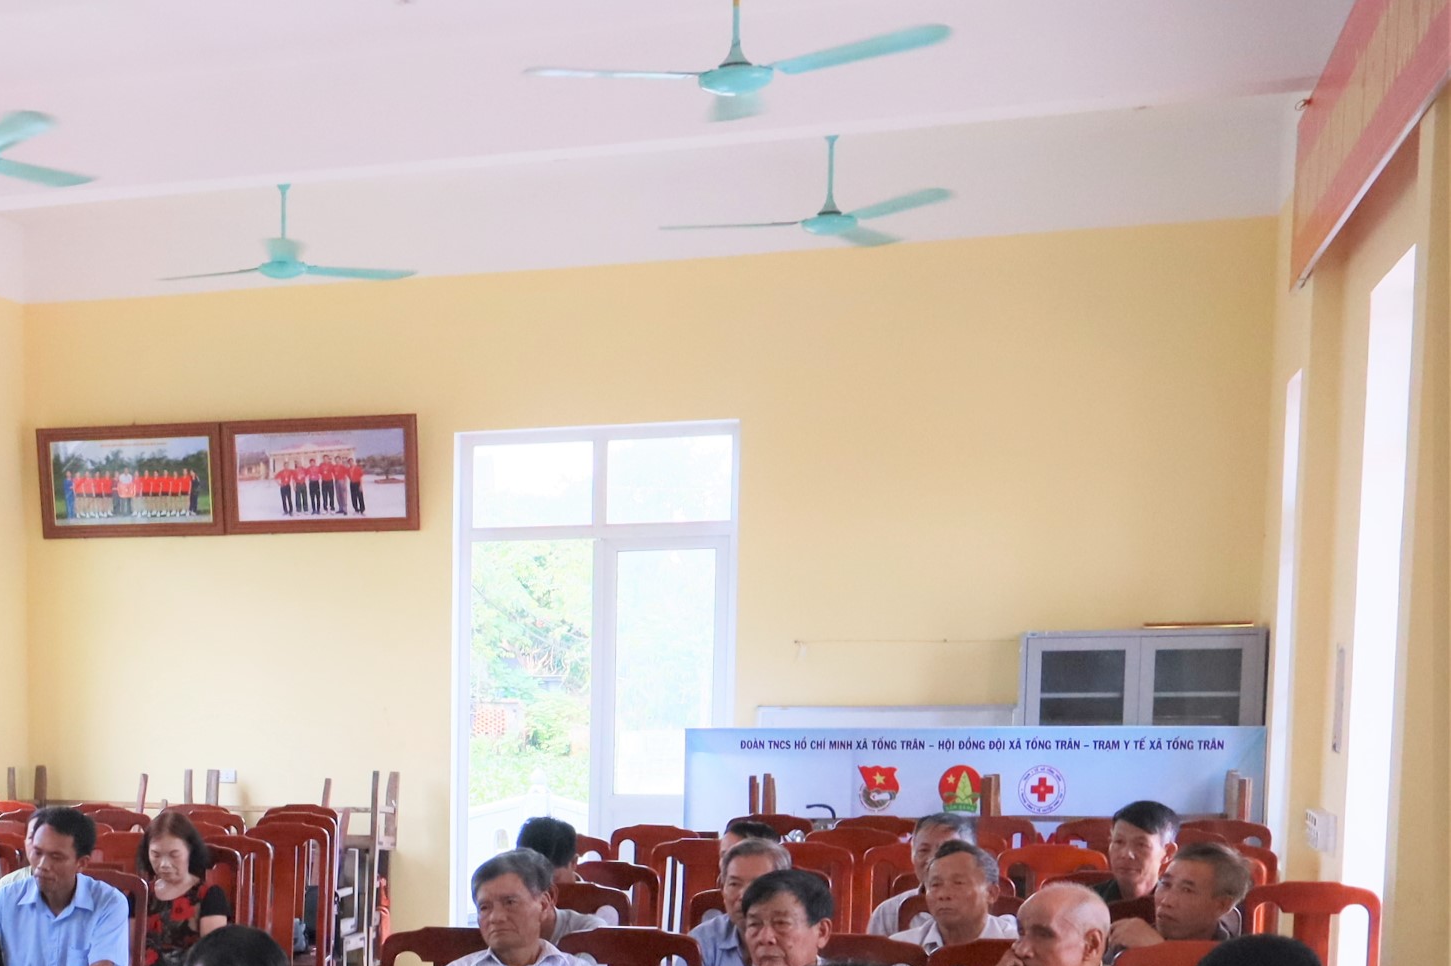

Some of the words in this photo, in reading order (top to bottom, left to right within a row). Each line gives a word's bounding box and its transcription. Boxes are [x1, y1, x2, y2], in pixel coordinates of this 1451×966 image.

[739, 737, 765, 750] ĐOÀN
[768, 740, 792, 750] TNCS
[810, 738, 826, 750] CHÍ
[828, 740, 853, 750] MINH
[900, 738, 926, 750] TRÂN
[938, 738, 955, 753] HỘI
[988, 738, 1006, 753] ĐỘI
[1008, 738, 1022, 750] XÃ
[1054, 737, 1081, 750] TRÂN
[1092, 740, 1121, 752] TRẠM
[1124, 740, 1131, 750] Y
[1133, 736, 1147, 750] TẾ
[1149, 738, 1163, 750] XÃ
[1166, 735, 1194, 750] TỐNG
[1197, 737, 1225, 750] TRÂN
